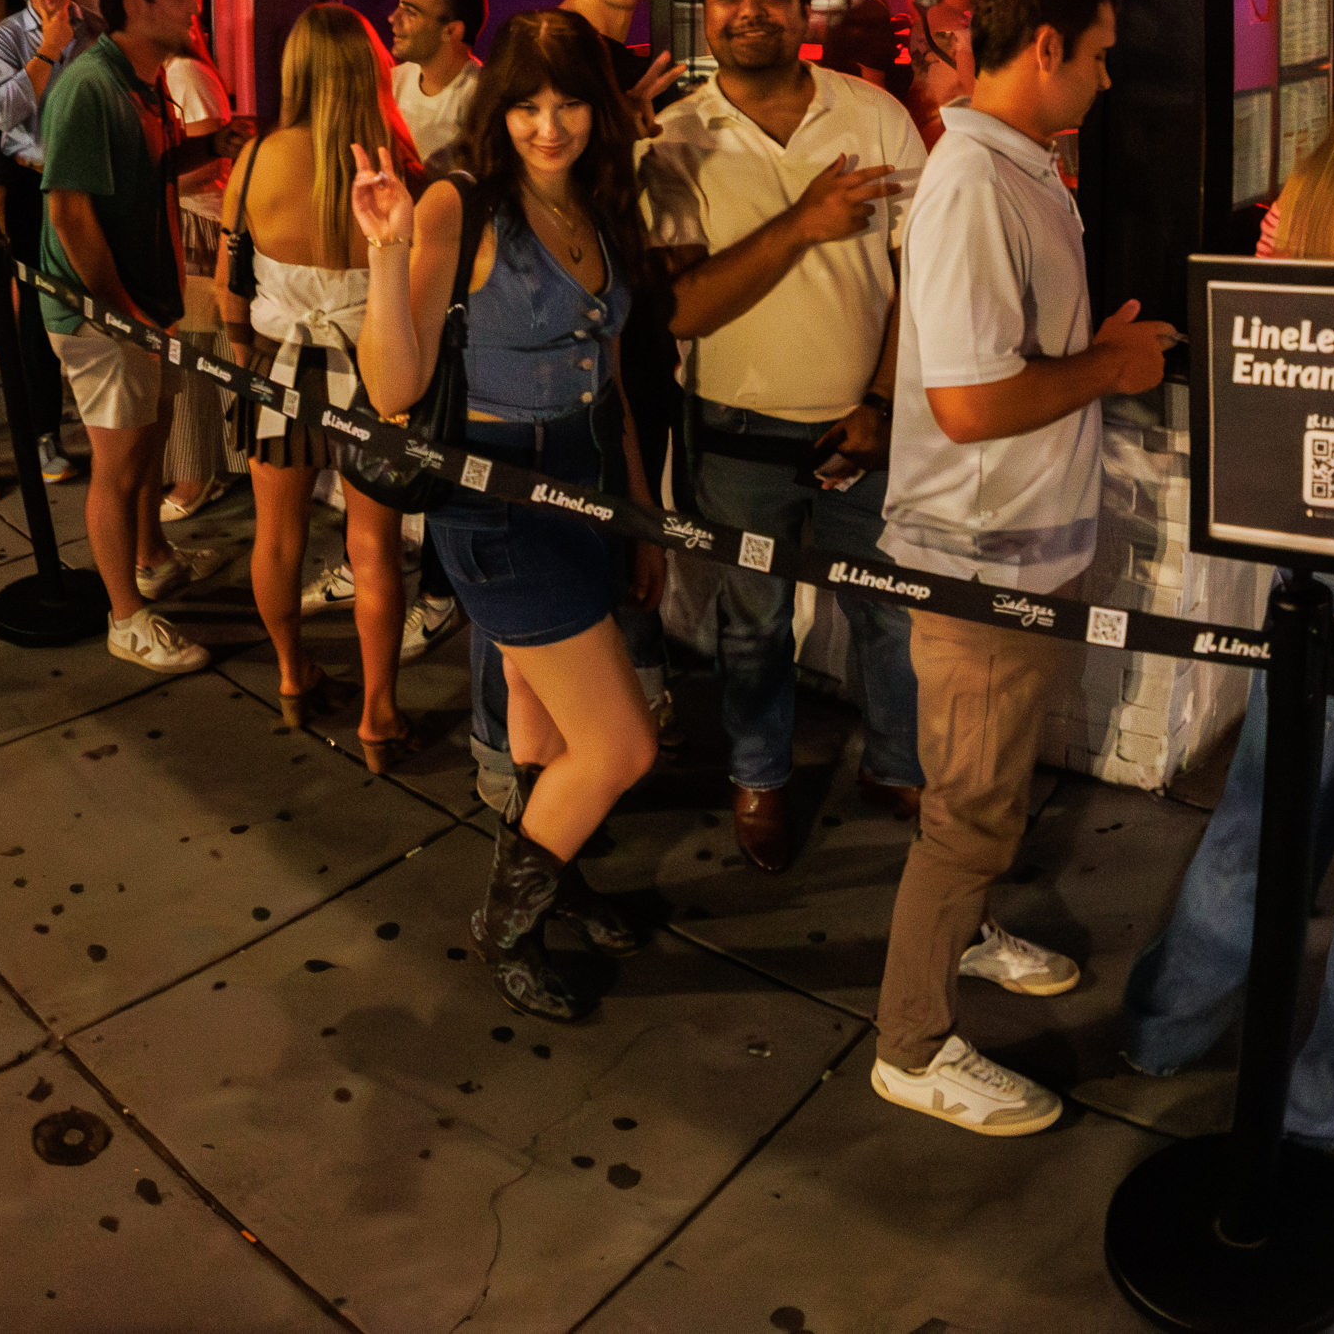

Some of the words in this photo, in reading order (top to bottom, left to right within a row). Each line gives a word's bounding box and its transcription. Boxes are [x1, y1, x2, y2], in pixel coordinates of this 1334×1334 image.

[547, 488, 615, 522] LineLeap
[849, 566, 932, 601] LineLeap
[992, 594, 1057, 628] Salazar
